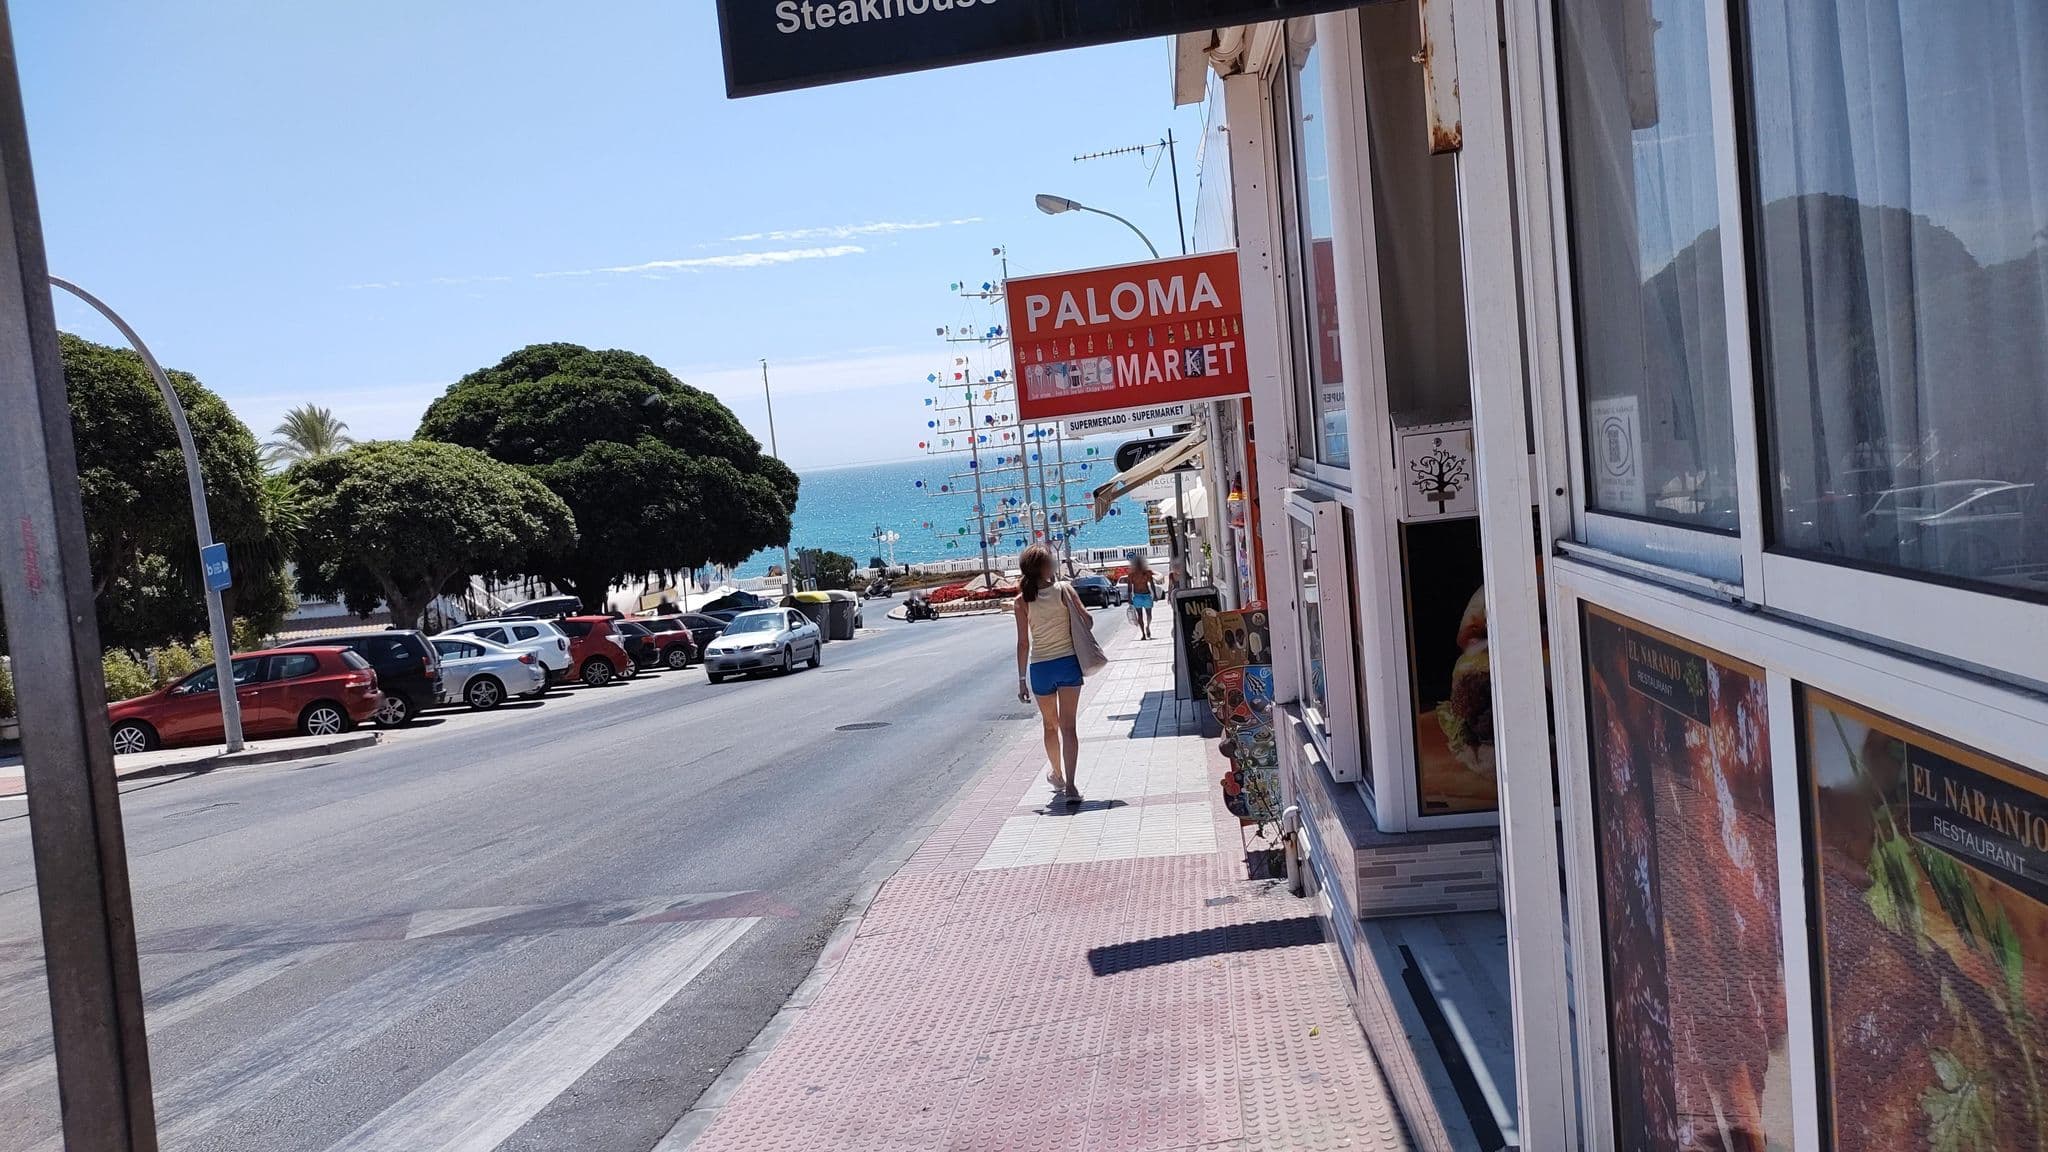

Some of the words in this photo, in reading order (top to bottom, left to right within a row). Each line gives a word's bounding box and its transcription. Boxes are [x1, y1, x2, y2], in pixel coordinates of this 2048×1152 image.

[1025, 272, 1224, 333] PALOMA
[1115, 341, 1236, 388] MARKET
[1069, 414, 1127, 431] SUPERMERCADO
[1131, 405, 1184, 422] SUPERMARKET
[1628, 639, 1640, 662] EL
[1640, 645, 1681, 681] NARANJO
[1637, 670, 1673, 697] RESTAURANT
[1912, 763, 1938, 802] EL
[1944, 776, 2048, 853] NARANJO
[1933, 815, 2026, 875] RESTAURANT
